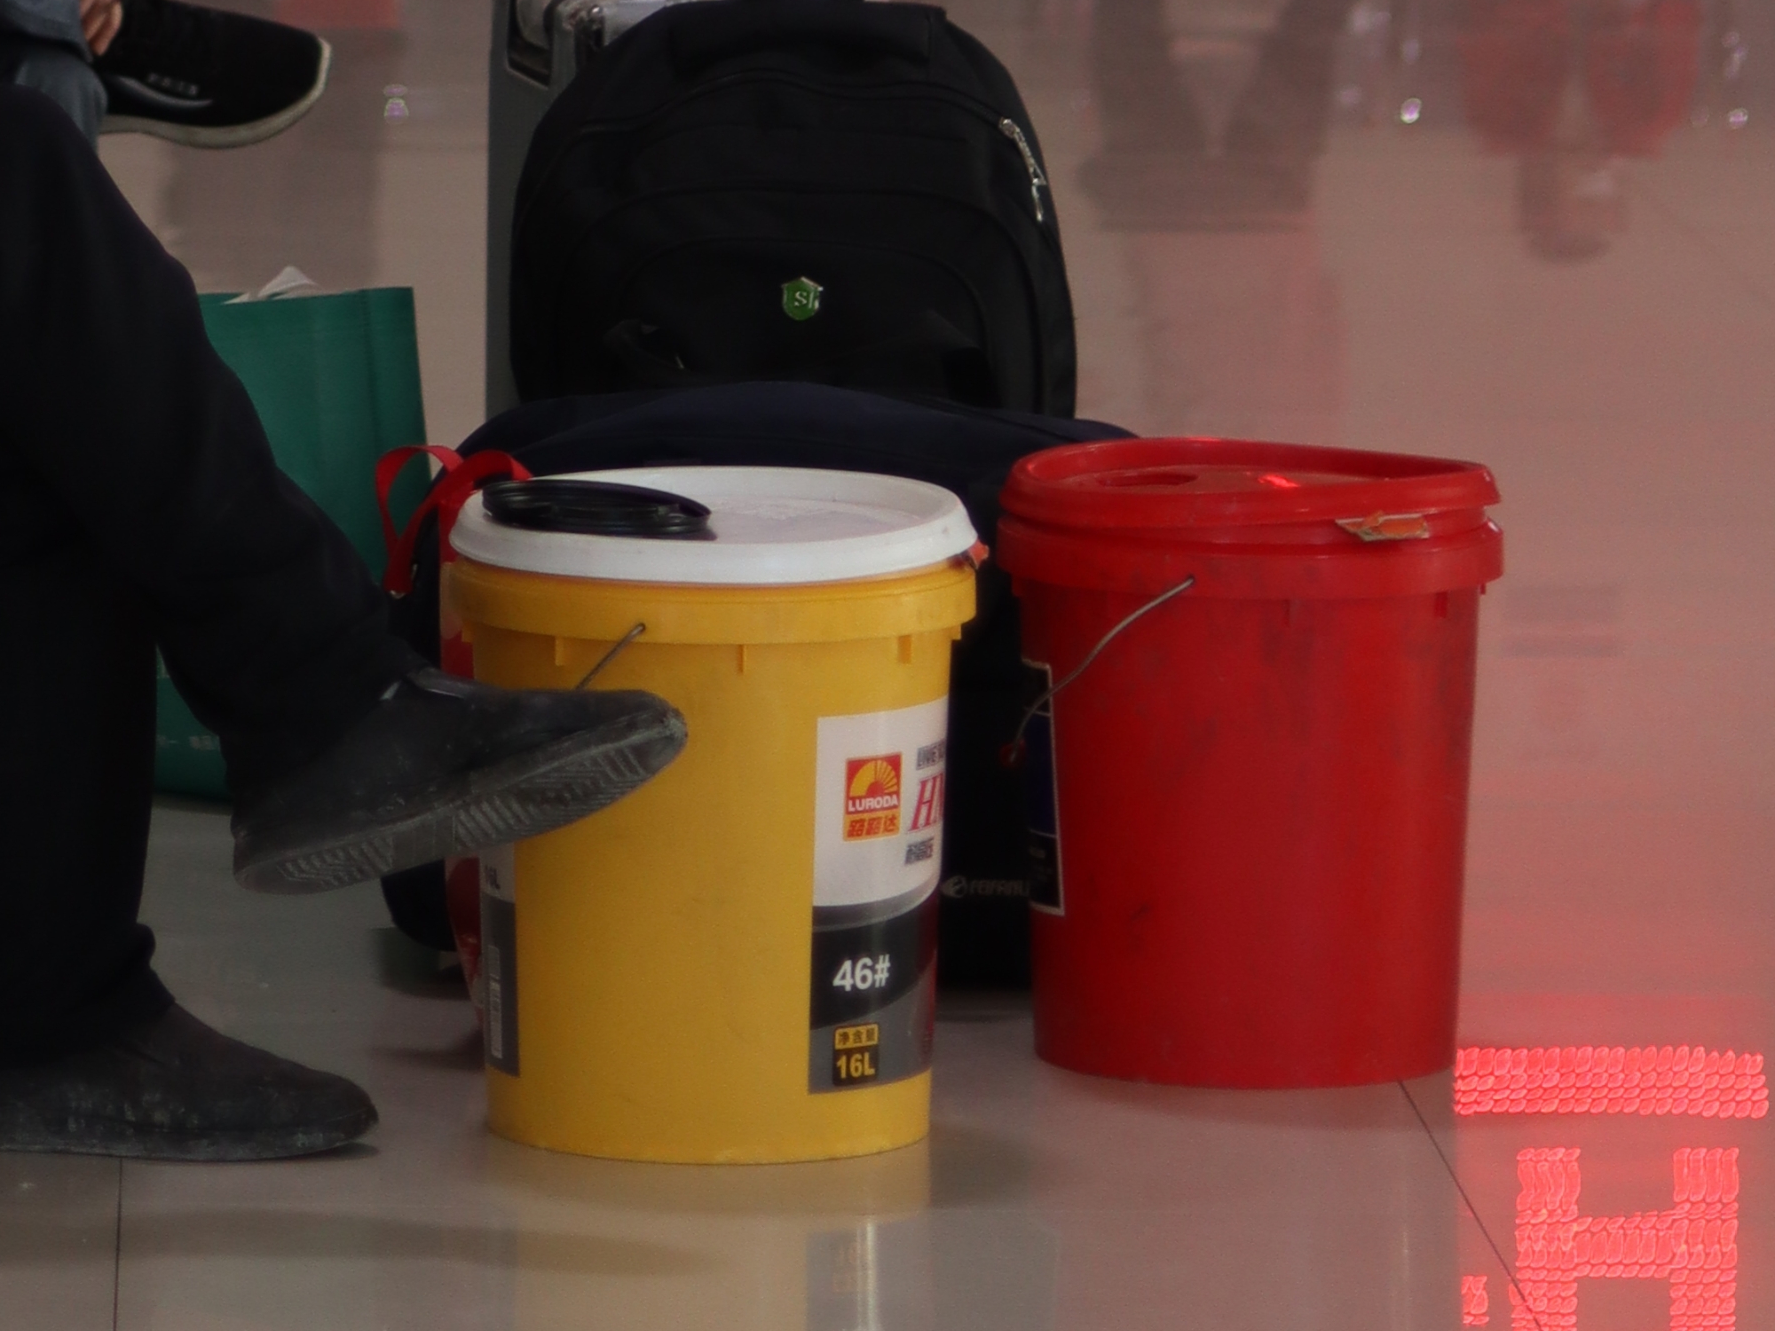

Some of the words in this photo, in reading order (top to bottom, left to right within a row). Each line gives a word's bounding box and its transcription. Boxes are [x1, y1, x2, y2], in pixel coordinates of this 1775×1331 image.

[847, 794, 899, 812] LURODA
[832, 953, 891, 991] 46#
[836, 1051, 876, 1079] 16L
